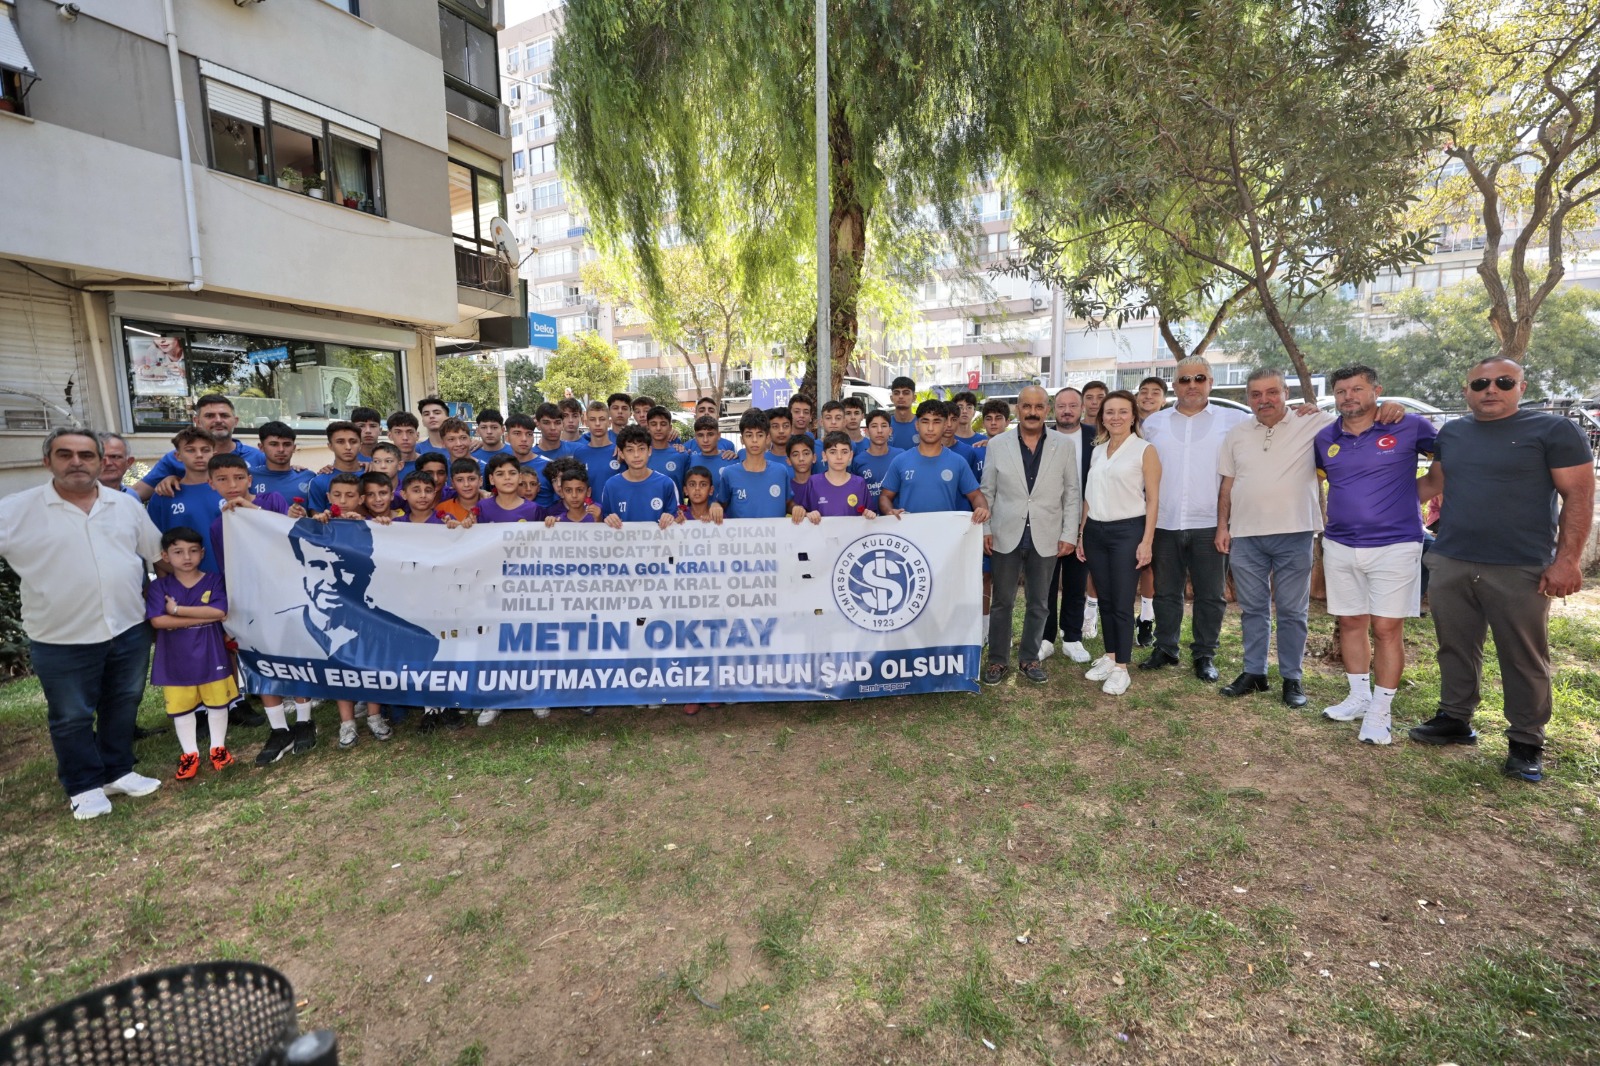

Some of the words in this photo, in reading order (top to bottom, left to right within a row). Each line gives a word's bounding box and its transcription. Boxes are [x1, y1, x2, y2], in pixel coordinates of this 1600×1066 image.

[535, 322, 554, 334] beko
[863, 469, 872, 479] 26
[905, 470, 914, 480] 27
[254, 483, 266, 494] 18
[867, 482, 881, 490] Delp
[737, 489, 747, 500] 24
[171, 502, 185, 515] 29
[618, 501, 627, 512] 27
[502, 530, 588, 542] DAMLACIK
[594, 529, 675, 541] SPOR'DAN
[680, 528, 721, 540] YOLA
[725, 526, 776, 541] ÇIKAN
[503, 543, 542, 559] YÜN
[679, 541, 712, 556] İLGİ
[718, 542, 776, 556] BULAN
[502, 560, 630, 576] İZMİRSPOR'DA
[635, 562, 670, 575] GOL
[676, 561, 725, 574] KRALI
[730, 560, 777, 573] OLAN
[501, 578, 668, 593] GALATASARAY'DA
[673, 577, 721, 591] KRAL
[727, 575, 777, 589] OLAN
[501, 594, 554, 612] MİLLİ
[561, 596, 653, 611] TAKIM'DA
[659, 594, 720, 609] YILDIZ
[726, 593, 777, 607] OLAN
[873, 619, 895, 627] 1923
[498, 613, 630, 652] METİN
[644, 617, 778, 649] OKTAY
[257, 660, 318, 684] SENİ
[324, 664, 468, 691] EBEDİYEN
[477, 660, 710, 691] UNUTMAYACAĞIZ
[719, 663, 811, 686] RUHUN
[821, 661, 872, 688] ŞAD
[880, 654, 964, 680] OLSUN
